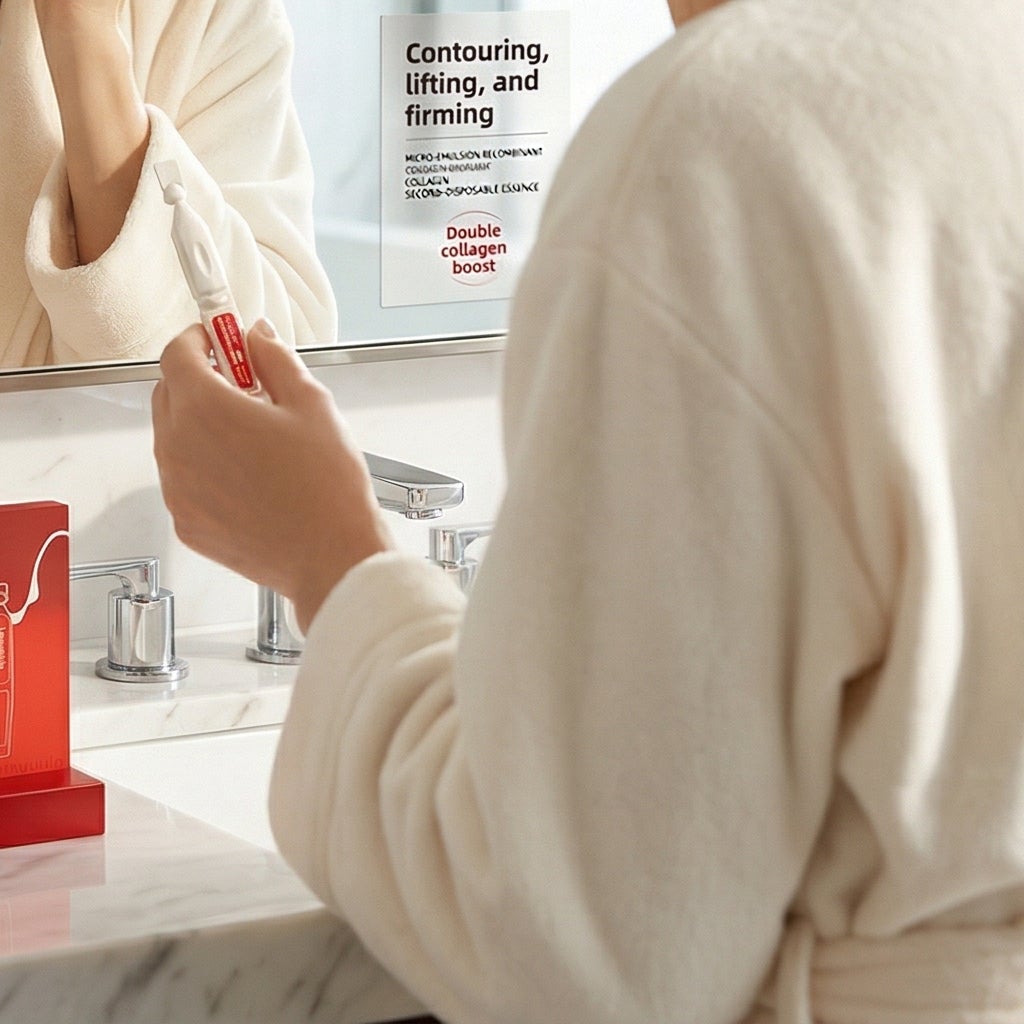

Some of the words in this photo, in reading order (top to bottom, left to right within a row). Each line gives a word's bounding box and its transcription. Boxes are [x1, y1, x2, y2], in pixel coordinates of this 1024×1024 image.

[406, 38, 549, 65] Contouring,
[406, 72, 485, 98] lifting,
[492, 68, 538, 92] and
[405, 102, 493, 128] firming
[447, 223, 501, 240] Double
[441, 242, 506, 259] collagen
[452, 259, 496, 274] boost
